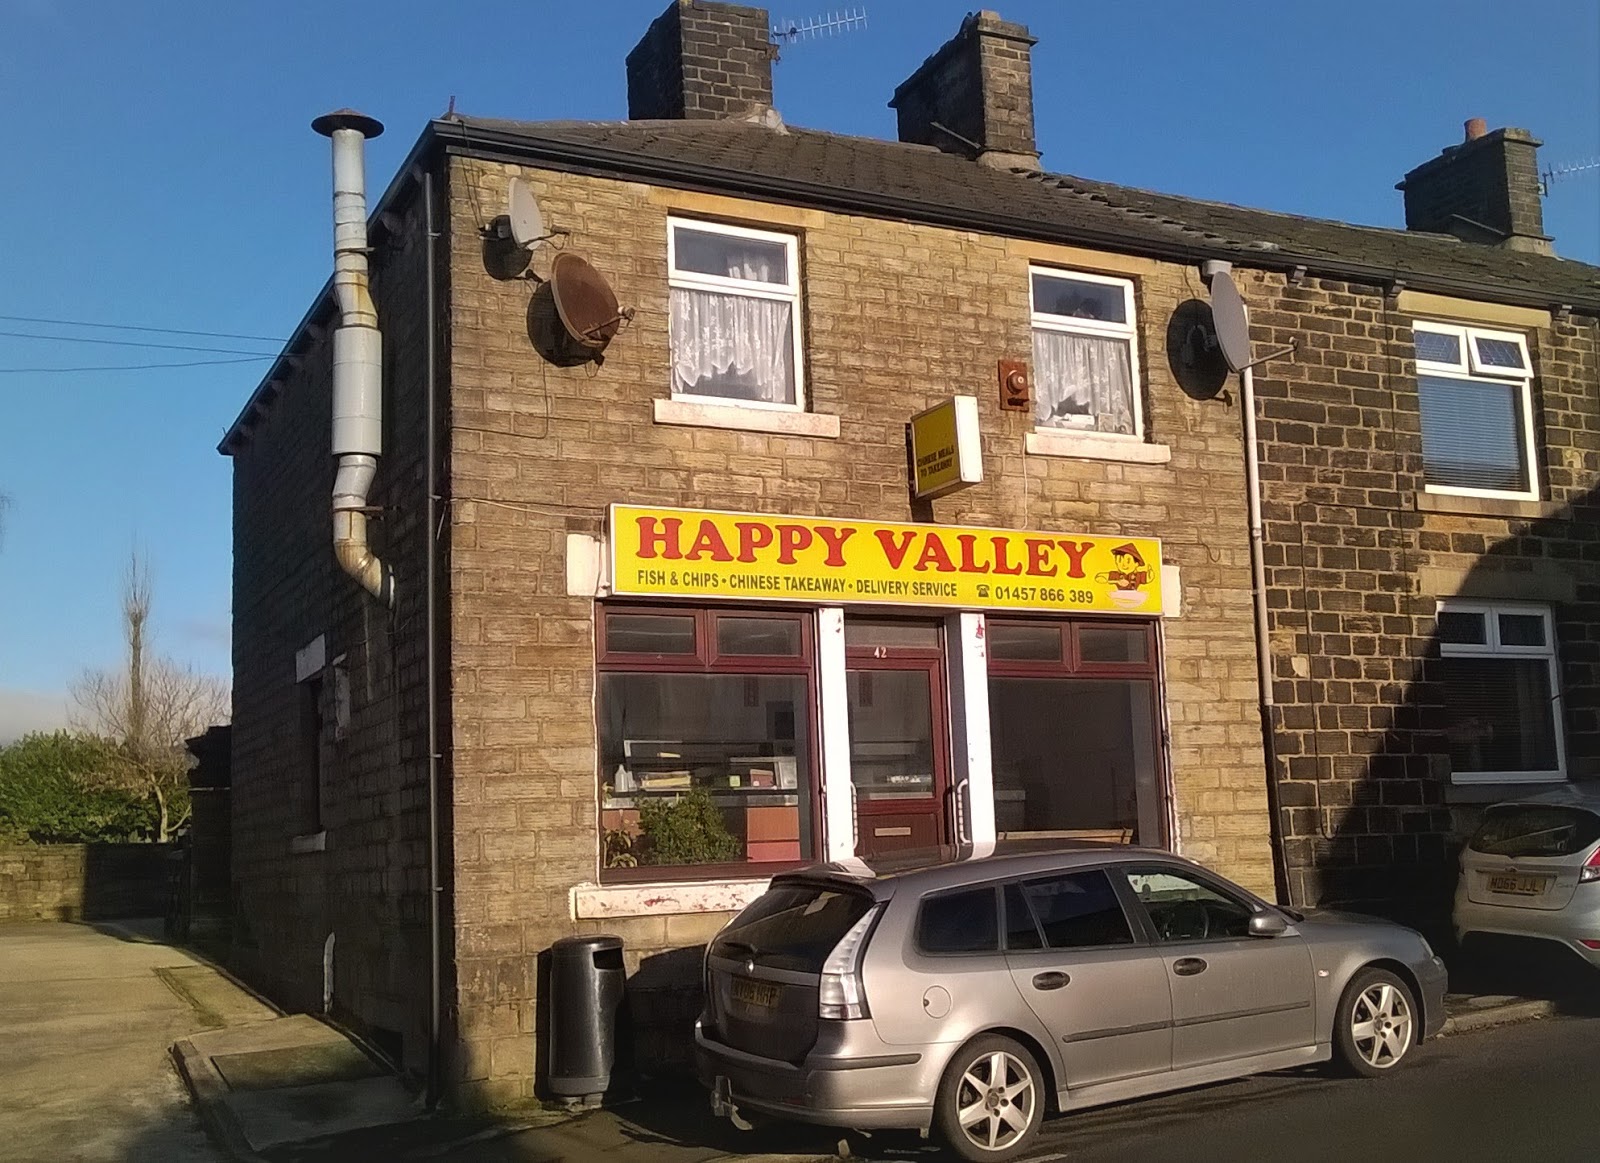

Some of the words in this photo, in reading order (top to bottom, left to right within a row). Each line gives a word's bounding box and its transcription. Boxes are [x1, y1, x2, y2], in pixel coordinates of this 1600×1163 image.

[635, 516, 857, 567] HAPPY
[874, 529, 1095, 579] VALLEY
[637, 569, 666, 586] FISH
[669, 571, 679, 586] &
[682, 571, 719, 588] CHIPS
[729, 573, 781, 591] CHINESE
[784, 576, 846, 594] TAKEAWAY
[856, 579, 909, 596] DELIVERY
[912, 581, 957, 598] SERVICE
[995, 586, 1036, 602] 01457
[1040, 588, 1065, 603] 866
[1069, 589, 1094, 605] 389
[873, 646, 888, 659] 42
